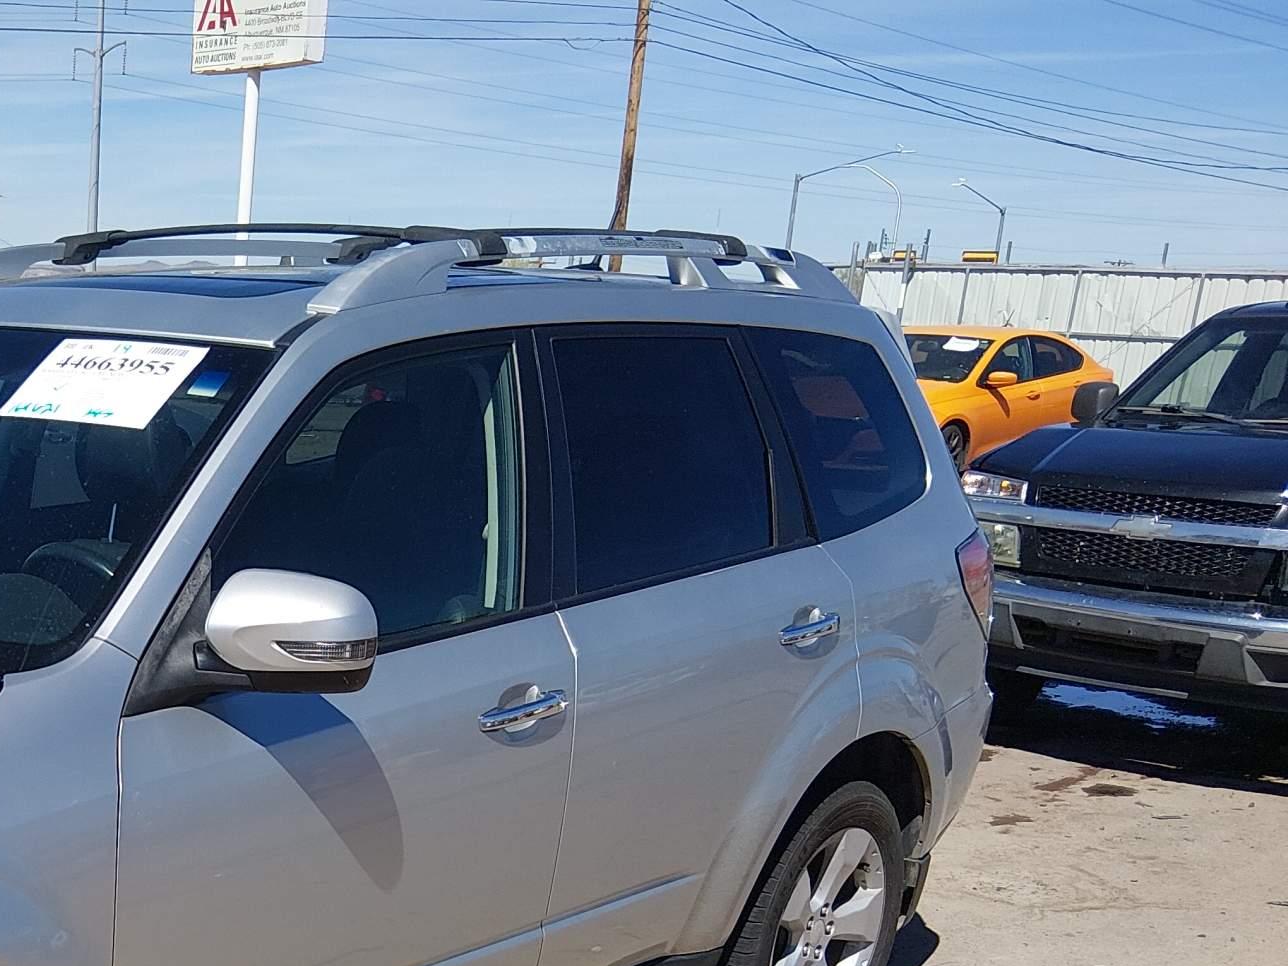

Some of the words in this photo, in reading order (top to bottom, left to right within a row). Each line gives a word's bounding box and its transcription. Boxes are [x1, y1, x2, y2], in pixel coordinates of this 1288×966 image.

[195, 34, 238, 50] INSURANCE
[194, 54, 210, 65] AUTO
[210, 51, 237, 63] AUCTIONS
[55, 354, 176, 376] 44663955
